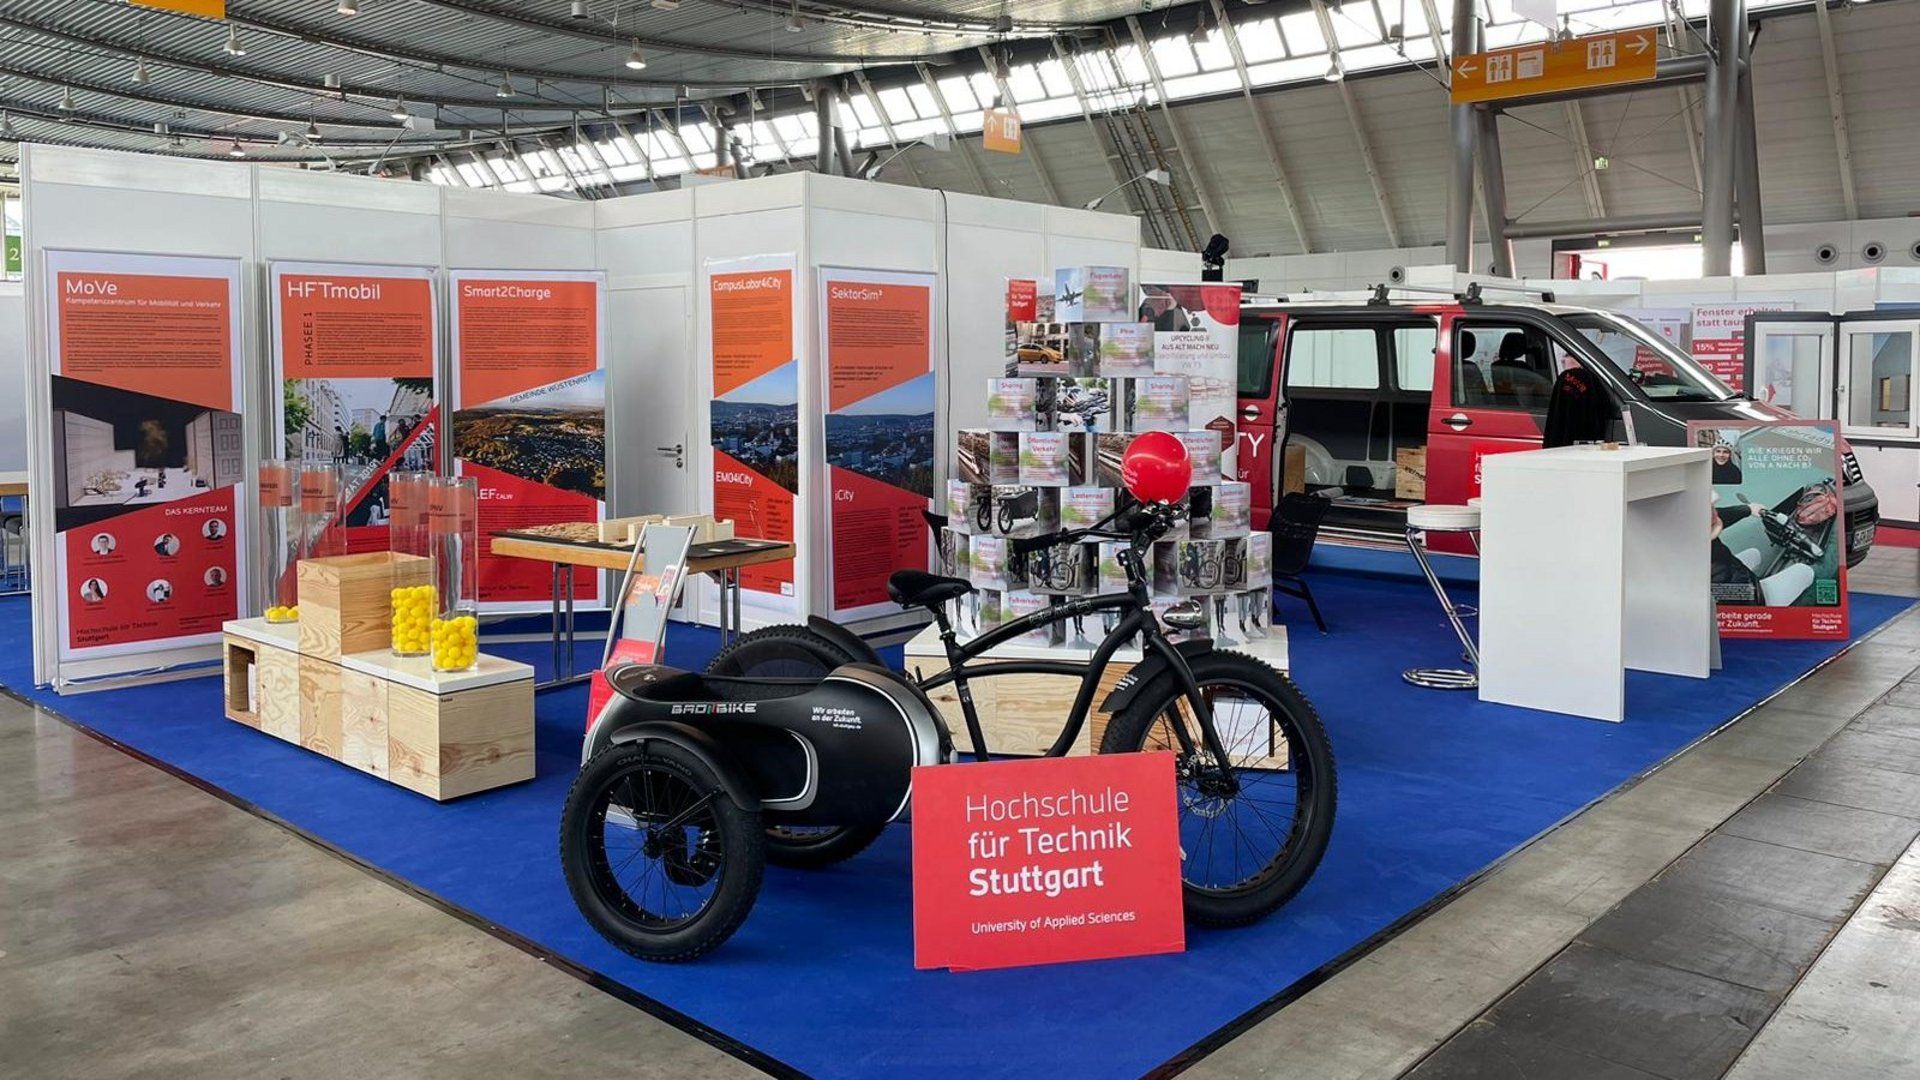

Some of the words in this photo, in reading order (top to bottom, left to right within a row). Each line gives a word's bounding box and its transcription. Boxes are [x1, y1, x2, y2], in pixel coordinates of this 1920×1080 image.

[66, 279, 118, 296] MoVe
[287, 281, 381, 300] HFTmobil
[463, 285, 552, 301] Smart2Charge
[1696, 308, 1735, 317] Fenster
[1696, 319, 1720, 327] statt
[509, 387, 546, 404] GEMEINDE
[834, 489, 854, 502] iCity
[165, 508, 181, 517] DAS
[182, 505, 228, 515] KERNTEAM
[1743, 613, 1773, 621] gerade
[1727, 620, 1761, 629] Zukunft.
[812, 706, 825, 715] Wir
[825, 707, 856, 717] arbeiten
[821, 714, 833, 722] der
[966, 786, 1130, 823] Hochschule
[968, 831, 1010, 860] für
[1018, 822, 1133, 856] Technik
[968, 860, 1104, 897] Stuttgart
[971, 918, 1028, 935] University
[1029, 917, 1043, 929] of
[1043, 913, 1086, 930] Applied
[1088, 910, 1136, 925] Sciences
